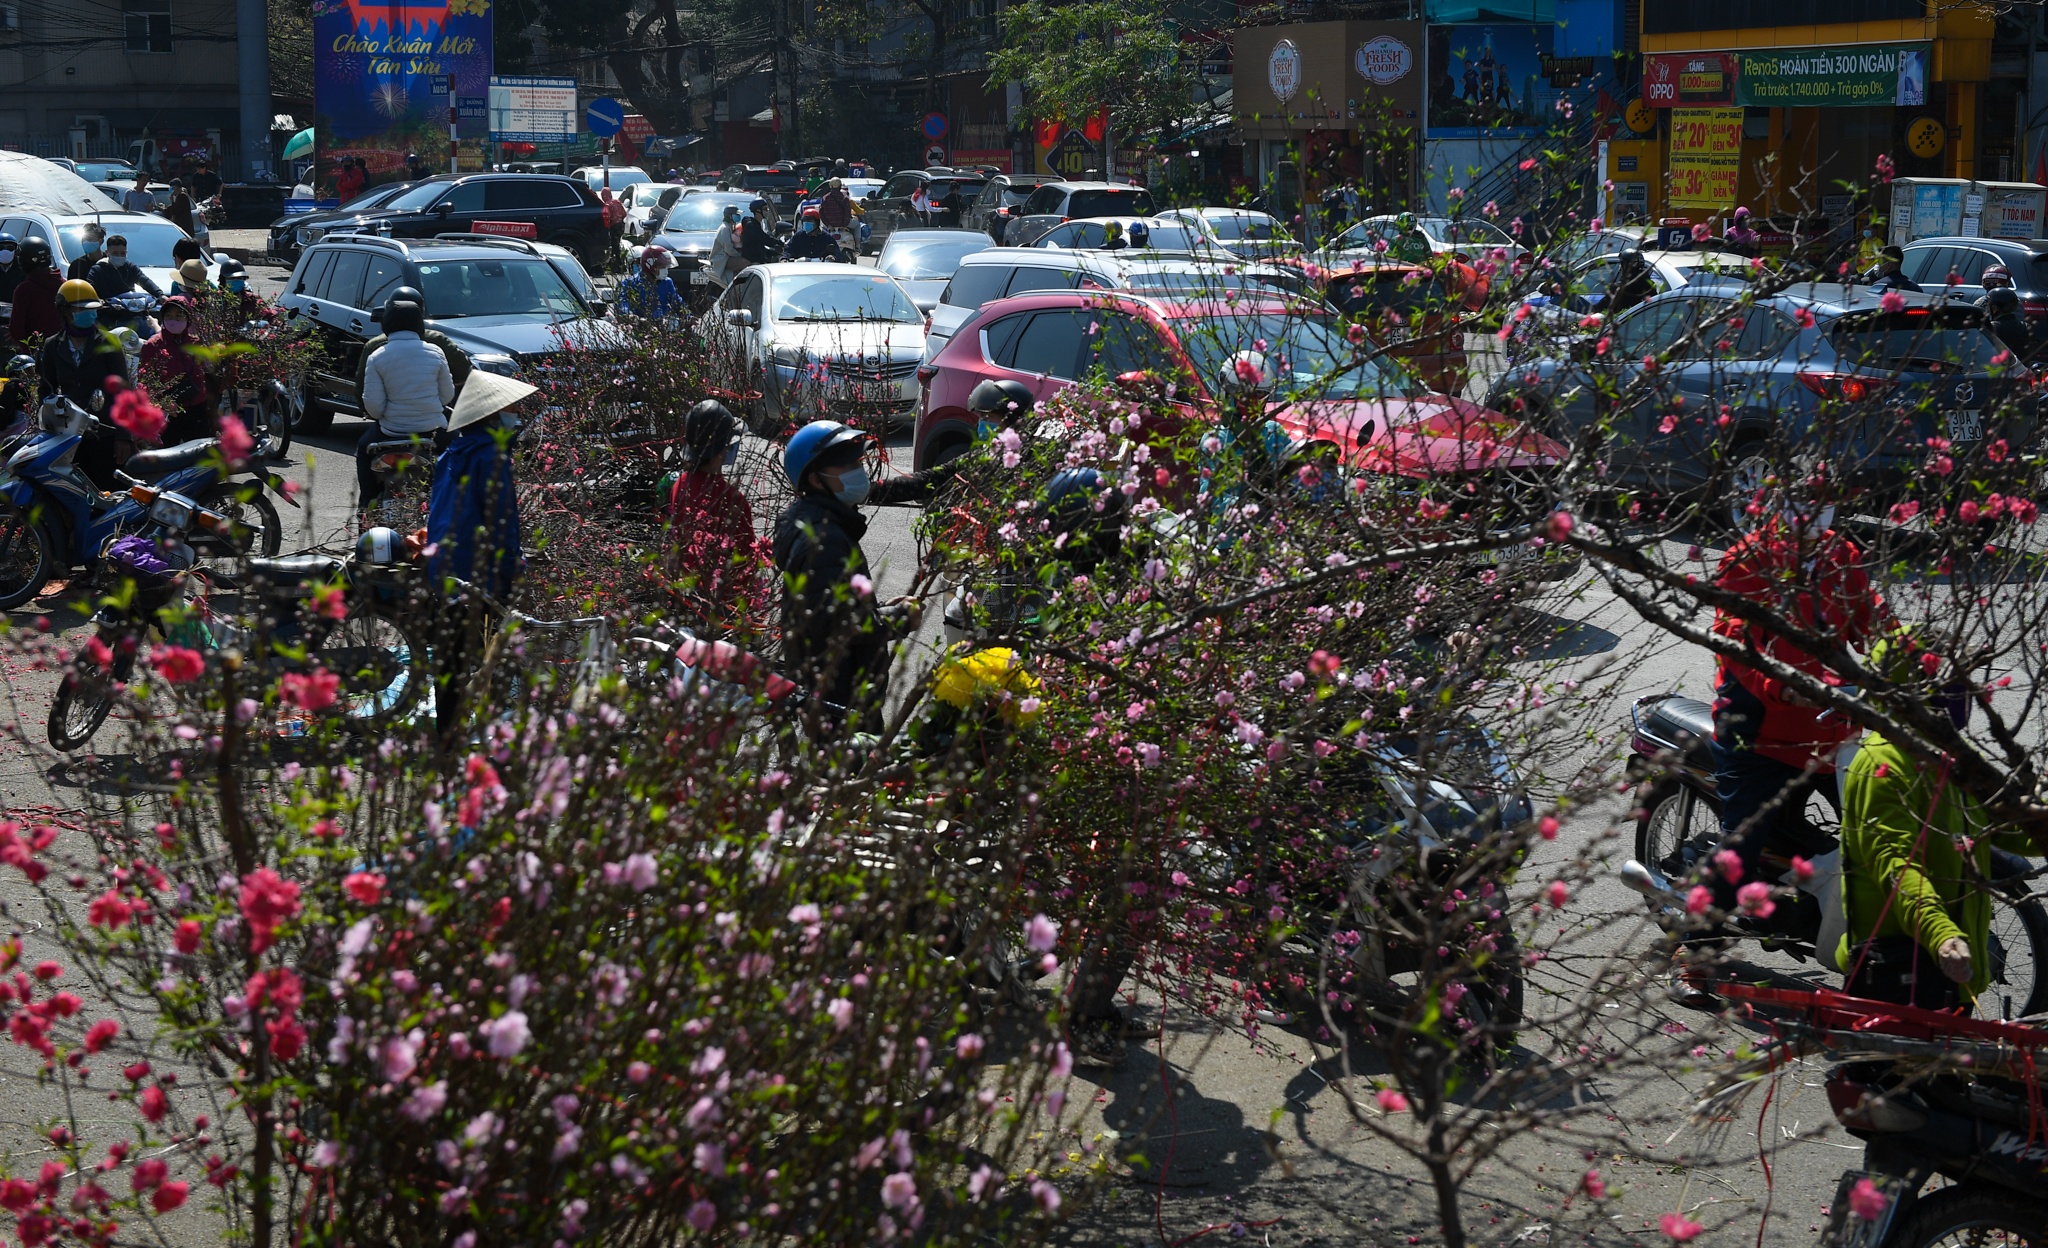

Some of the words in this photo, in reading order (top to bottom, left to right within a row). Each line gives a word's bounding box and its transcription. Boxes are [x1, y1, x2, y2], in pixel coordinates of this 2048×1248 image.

[333, 34, 379, 54] Chào
[383, 36, 432, 54] Xuân
[437, 36, 476, 55] Mới
[1364, 50, 1403, 65] FRESH
[1745, 58, 1778, 76] Reno5
[1780, 55, 1808, 75] HOÀN
[1810, 52, 1834, 75] TIỀN
[1836, 55, 1857, 74] 300
[1859, 51, 1895, 73] NGÀN
[368, 56, 401, 75] Tân
[406, 56, 441, 75] Sửu
[1274, 59, 1293, 77] FRESH
[1369, 64, 1400, 73] FOODS
[1541, 54, 1593, 77] TOMORROW
[1688, 61, 1705, 75] TẶNG
[1276, 75, 1291, 86] FOODS
[1682, 78, 1702, 89] 1.000
[1650, 84, 1674, 99] OPPO
[1754, 83, 1768, 97] Trả
[1768, 82, 1789, 97] trước
[1790, 82, 1830, 97] 1.740.000
[1837, 79, 1851, 96] Trả
[1852, 81, 1868, 98] góp
[1870, 80, 1884, 94] 0%
[460, 107, 473, 116] XUÂN
[1713, 121, 1727, 134] GIẢM
[1713, 136, 1725, 151] ĐẾN
[1057, 152, 1083, 173] 40
[1711, 167, 1728, 180] GIẢM
[1714, 183, 1727, 198] ĐẾN
[2008, 206, 2019, 221] TÓC
[2021, 209, 2036, 222] NAM
[1403, 238, 1424, 250] Grab
[1669, 230, 1685, 248] G7
[1952, 411, 1971, 425] 30A
